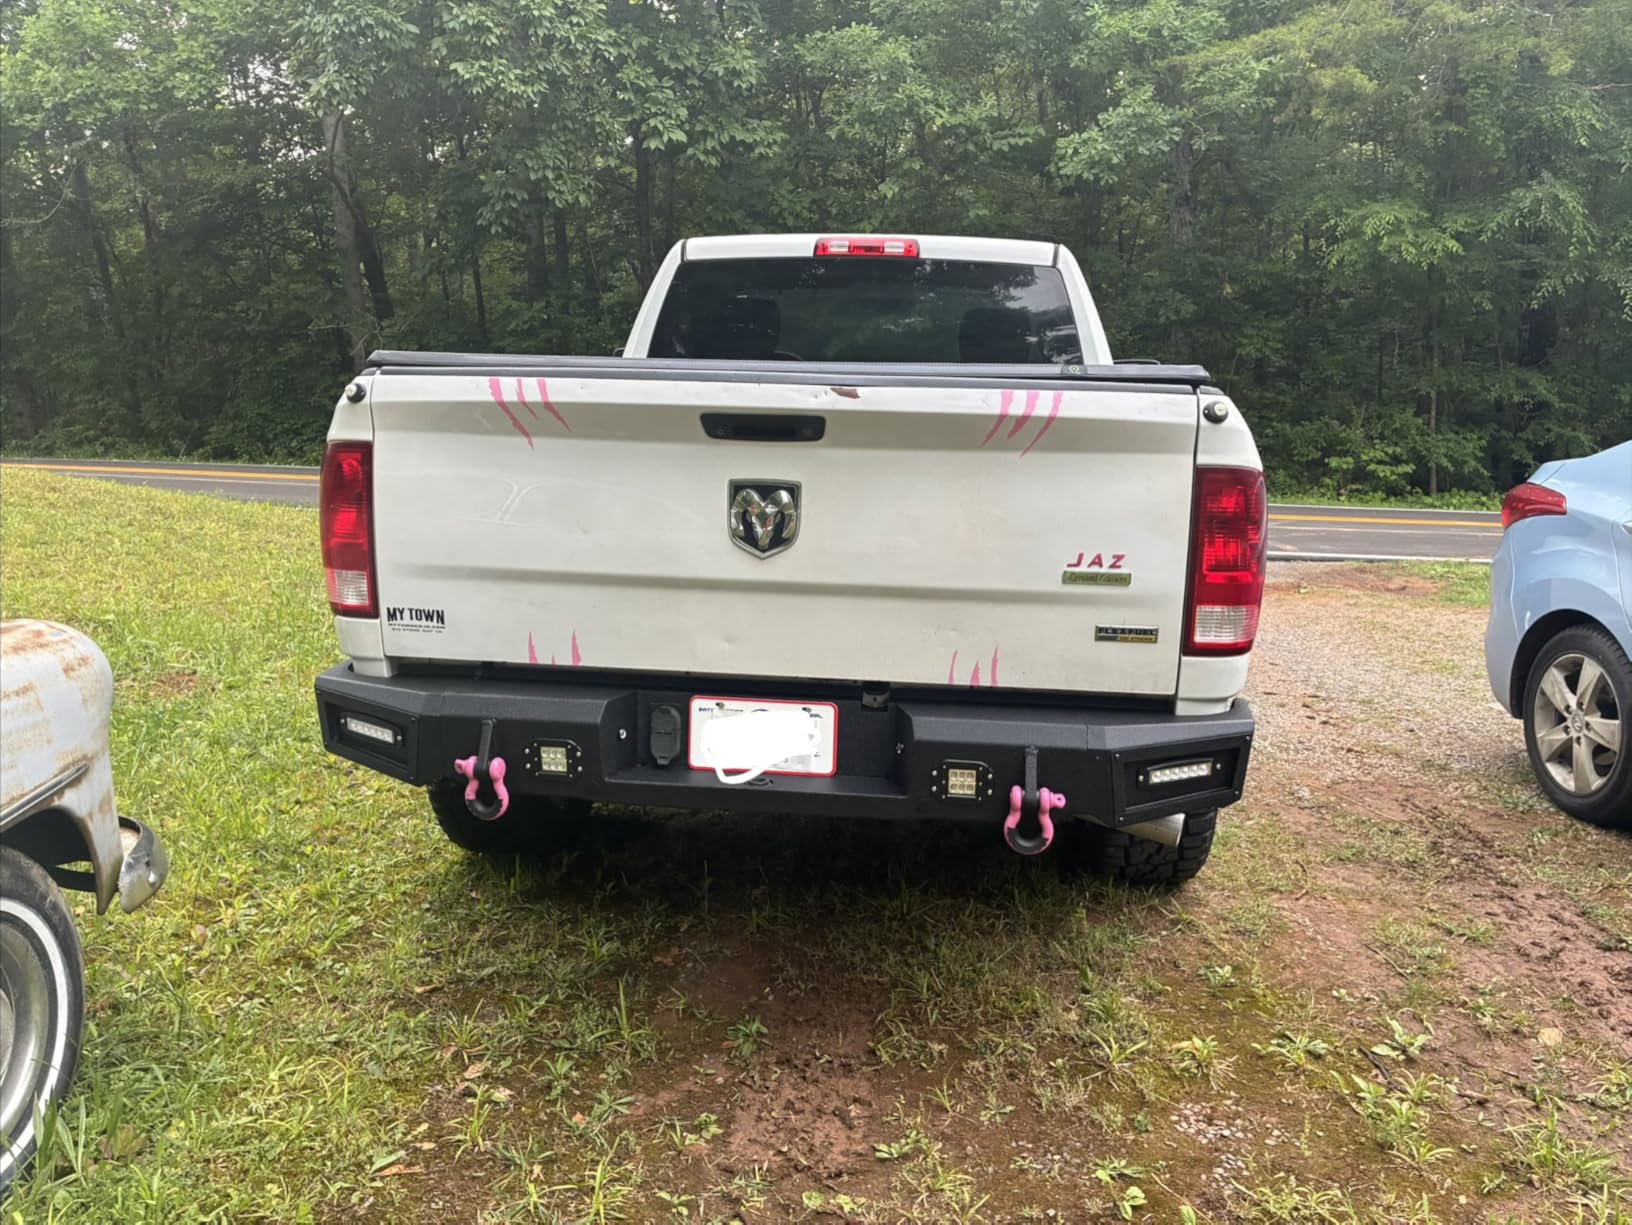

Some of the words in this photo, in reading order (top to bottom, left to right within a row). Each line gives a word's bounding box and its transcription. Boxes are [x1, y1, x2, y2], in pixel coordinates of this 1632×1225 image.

[1066, 552, 1126, 569] JAZ
[386, 606, 405, 622] MY
[407, 607, 445, 625] TOWN
